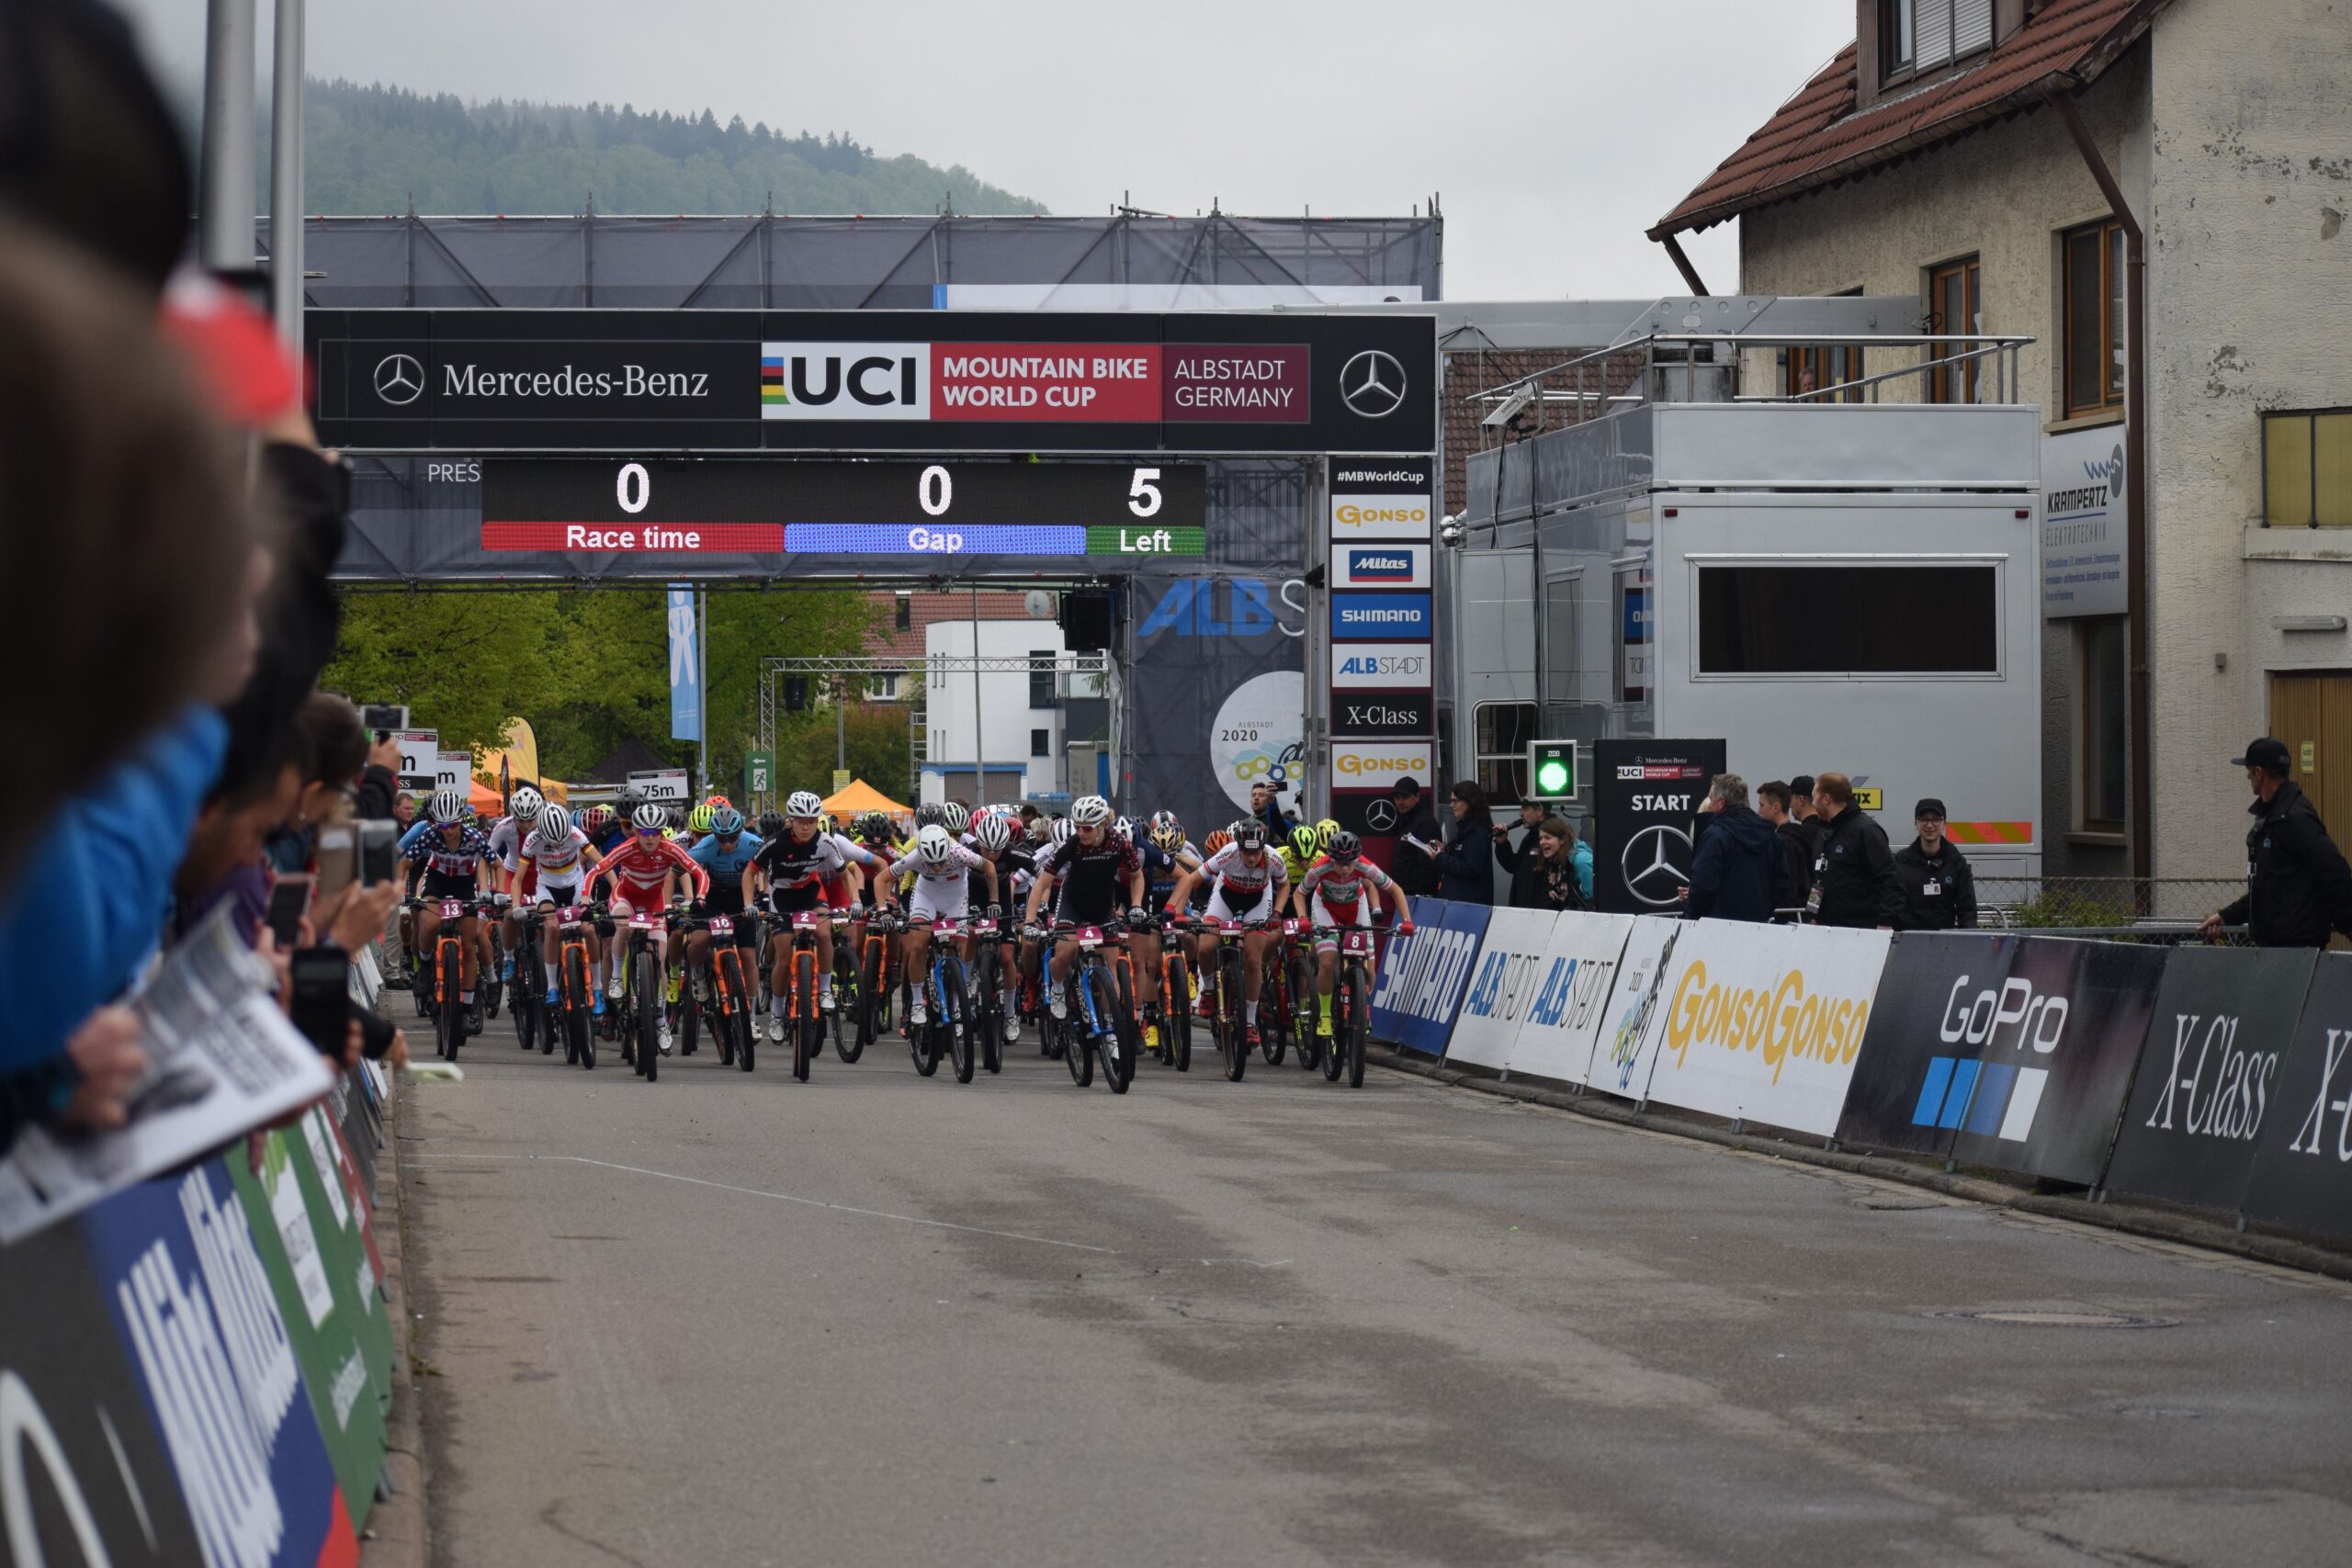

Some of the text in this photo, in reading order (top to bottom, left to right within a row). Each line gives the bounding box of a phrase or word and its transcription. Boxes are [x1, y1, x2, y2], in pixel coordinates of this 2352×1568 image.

[944, 357, 1148, 379] MOUNTAIN BIKE
[1175, 359, 1286, 380] ALBSTADT
[443, 364, 708, 397] Mercedes-Benz
[791, 356, 916, 406] UCI
[943, 386, 1097, 407] WORLD CUP
[1175, 387, 1294, 408] GERMANY
[616, 463, 650, 513] 0
[1338, 470, 1424, 485] #MBWorldCup
[919, 466, 952, 515] 0
[1128, 468, 1161, 517] 5
[2047, 485, 2108, 513] KRAMPERTZ
[566, 525, 700, 549] Race time
[908, 528, 963, 554] Gap
[1120, 529, 1171, 553] Left
[2046, 521, 2107, 547] ELEKTROTECHNIK
[1355, 557, 1408, 570] Mitas
[1341, 609, 1421, 622] SHIMANO
[1338, 656, 1425, 675] ALBSTADT
[1347, 705, 1418, 726] X-Class
[1222, 729, 1258, 741] 2020
[1622, 768, 1643, 777] UCI
[642, 784, 674, 797] 75m
[1631, 795, 1690, 811] START
[443, 903, 459, 916] 13
[563, 908, 572, 920] 5
[636, 913, 645, 921] 3
[800, 913, 809, 922] 2
[940, 920, 947, 929] 1
[1085, 930, 1094, 938] 4
[1351, 935, 1360, 949] 8
[1373, 925, 1476, 1024] SHIMANO
[1464, 951, 1540, 1022] ALBSTADT
[1527, 956, 1613, 1031] ALBSTADT
[1939, 974, 2069, 1054] GoPro
[2145, 1013, 2279, 1141] X-Class
